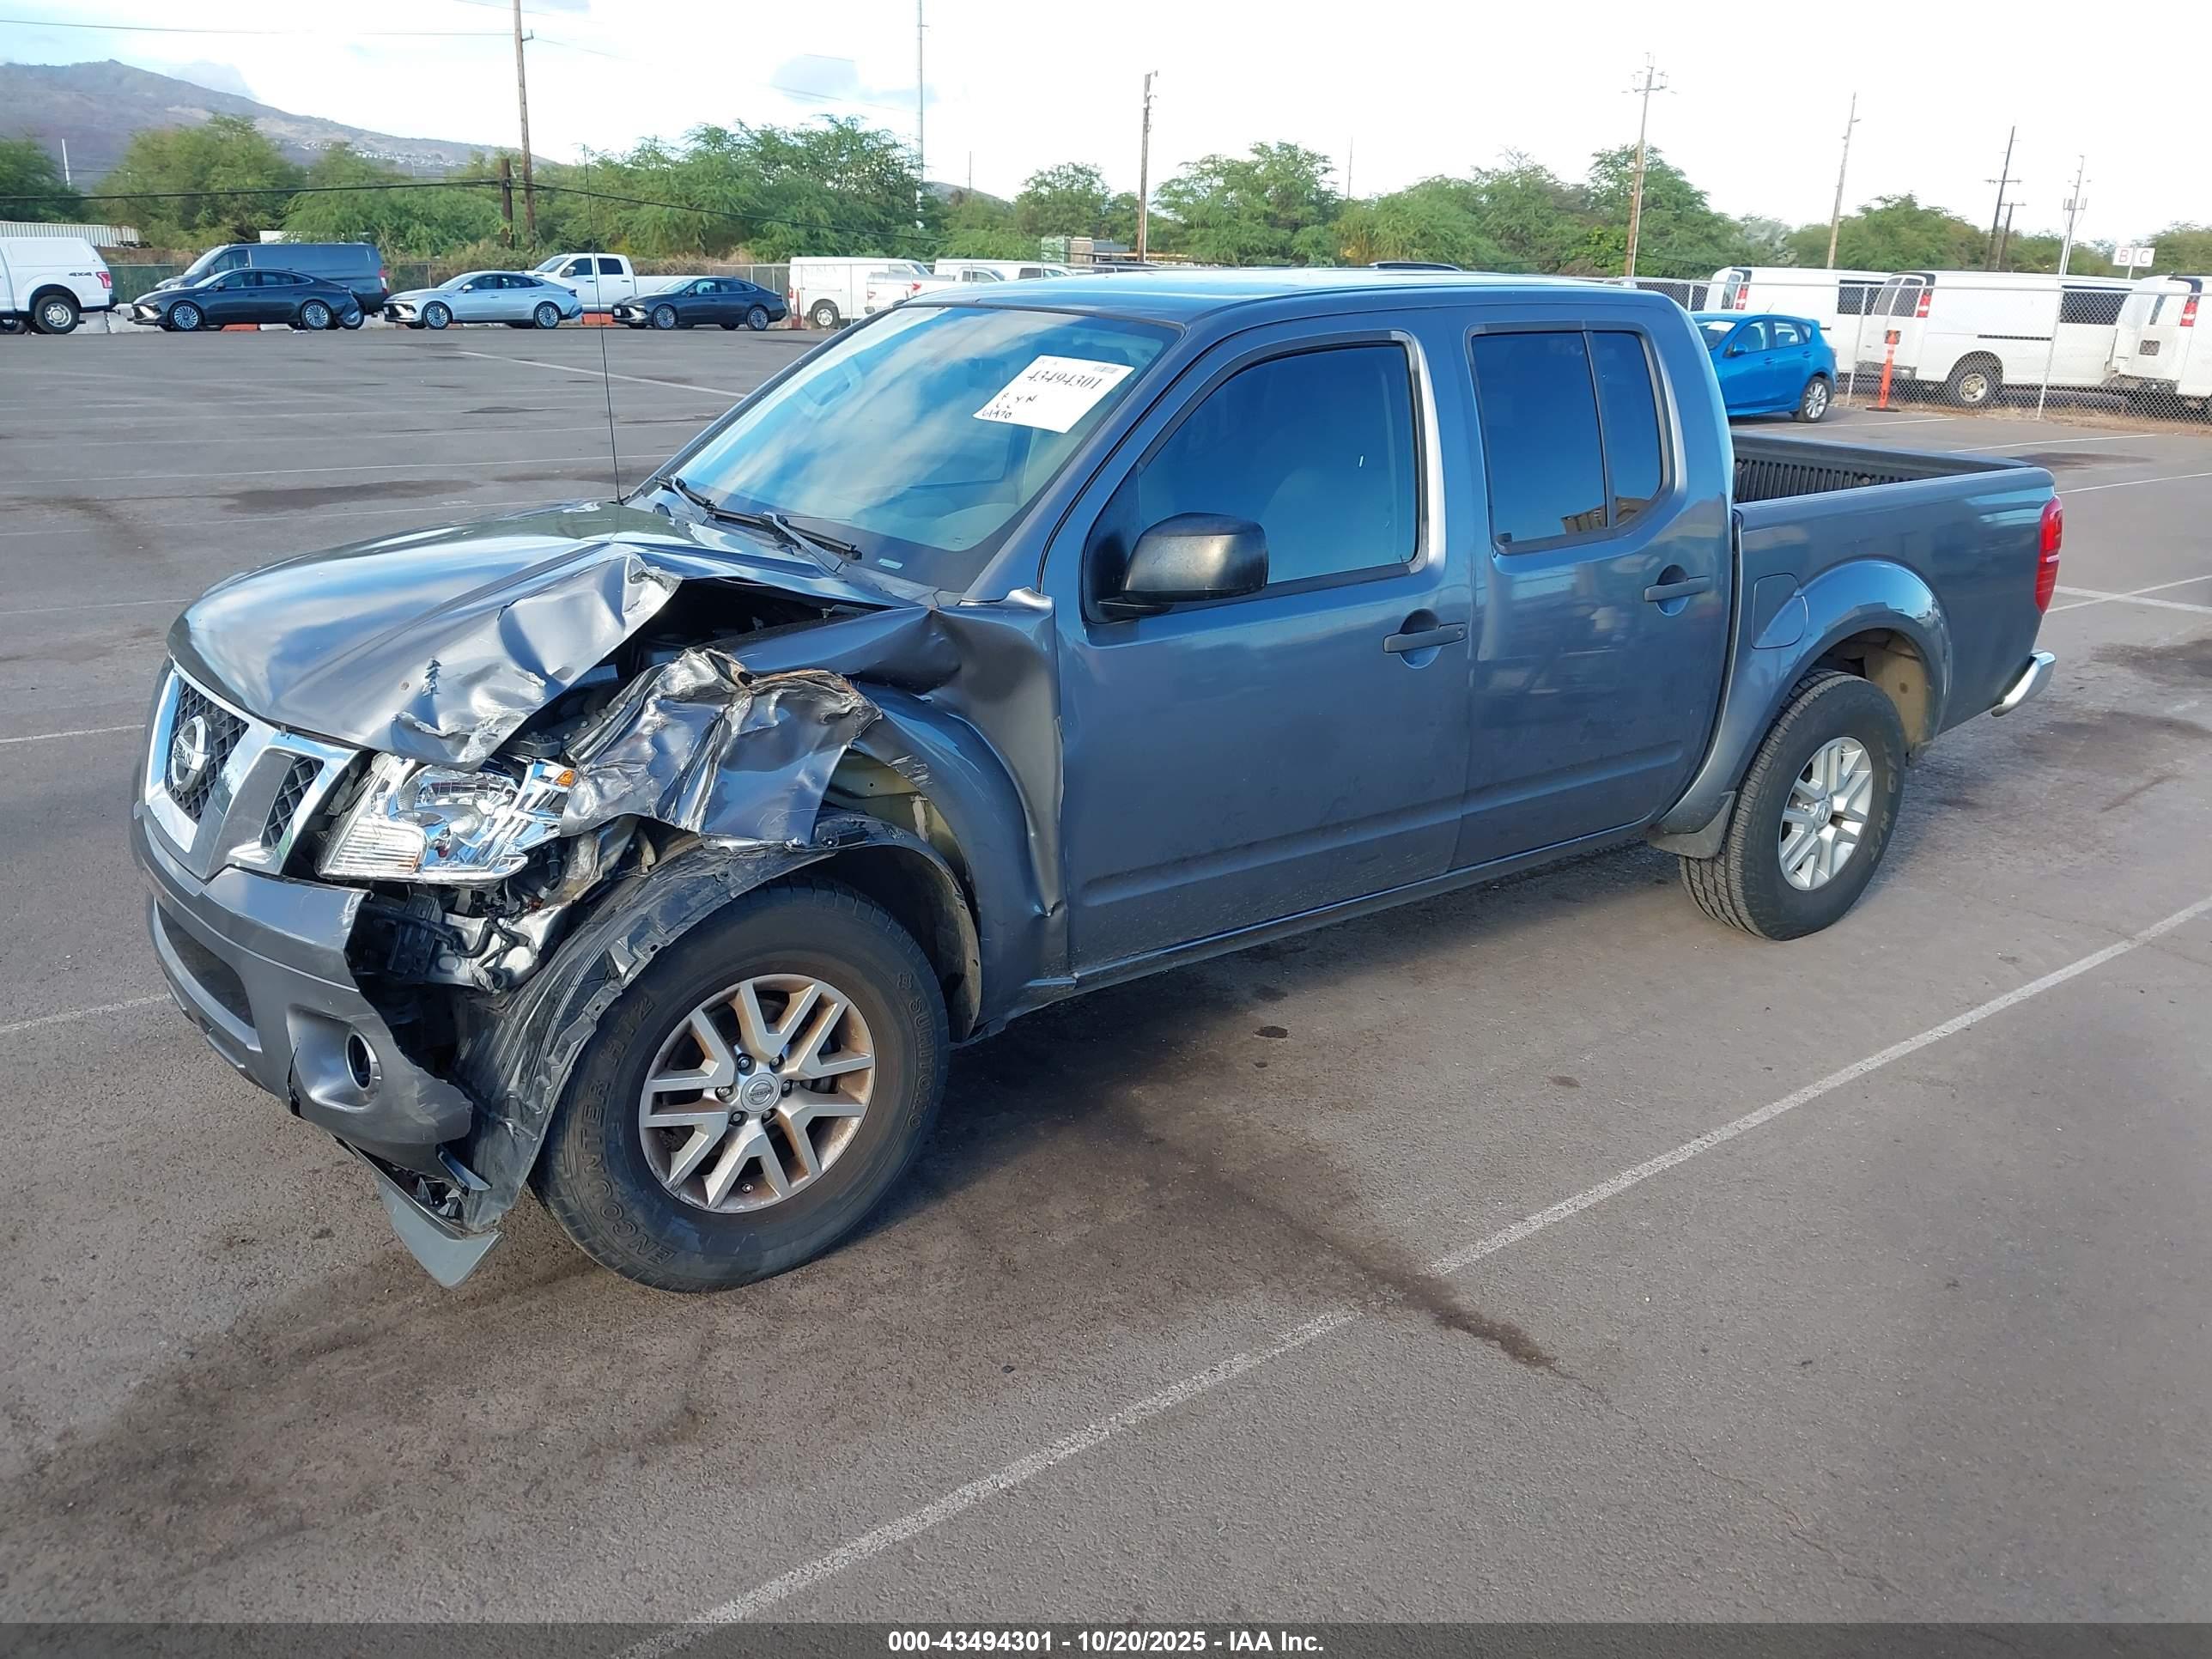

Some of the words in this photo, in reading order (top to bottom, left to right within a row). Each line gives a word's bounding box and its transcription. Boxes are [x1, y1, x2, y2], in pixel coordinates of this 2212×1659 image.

[2118, 249, 2129, 262] B
[2140, 250, 2149, 264] C
[1027, 370, 1104, 390] 43494301
[908, 996, 934, 1129] SUMITOMO
[580, 1079, 677, 1265] ENCOUNTER
